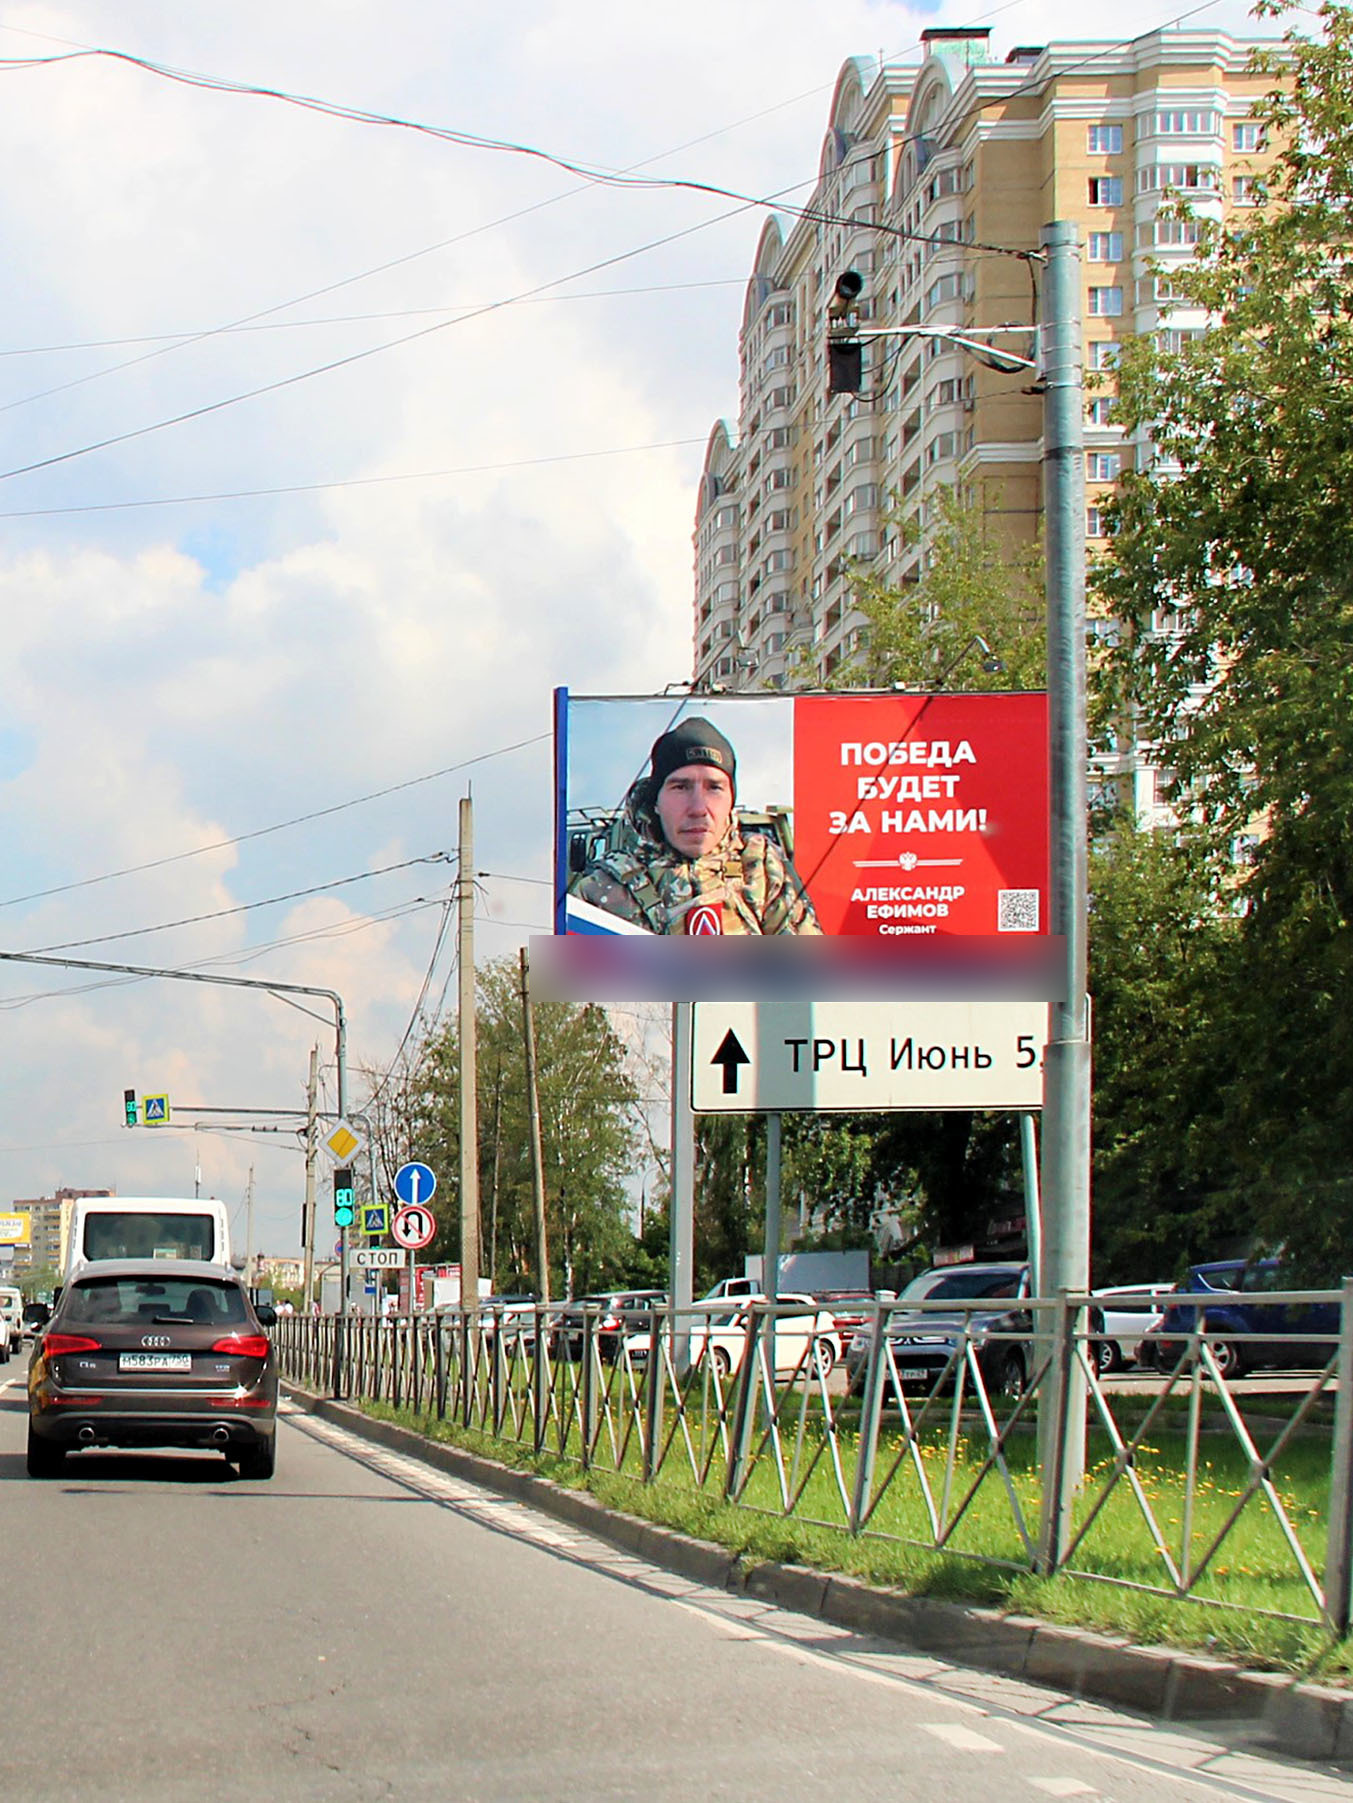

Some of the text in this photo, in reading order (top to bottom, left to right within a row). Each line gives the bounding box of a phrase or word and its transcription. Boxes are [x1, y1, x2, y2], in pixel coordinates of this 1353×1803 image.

[841, 741, 977, 768] ПОБЕДА
[858, 775, 960, 803] БУДЕТ
[829, 809, 987, 834] ЗА НАМИ!
[851, 886, 965, 902] АЛЕКСАНДР
[867, 903, 949, 919] ЕФИМОВ
[879, 924, 936, 935] Сержант
[784, 1038, 867, 1077] ТРЦ
[891, 1037, 992, 1070] Июнь
[336, 1188, 353, 1206] 80
[357, 1252, 398, 1265] СТОП
